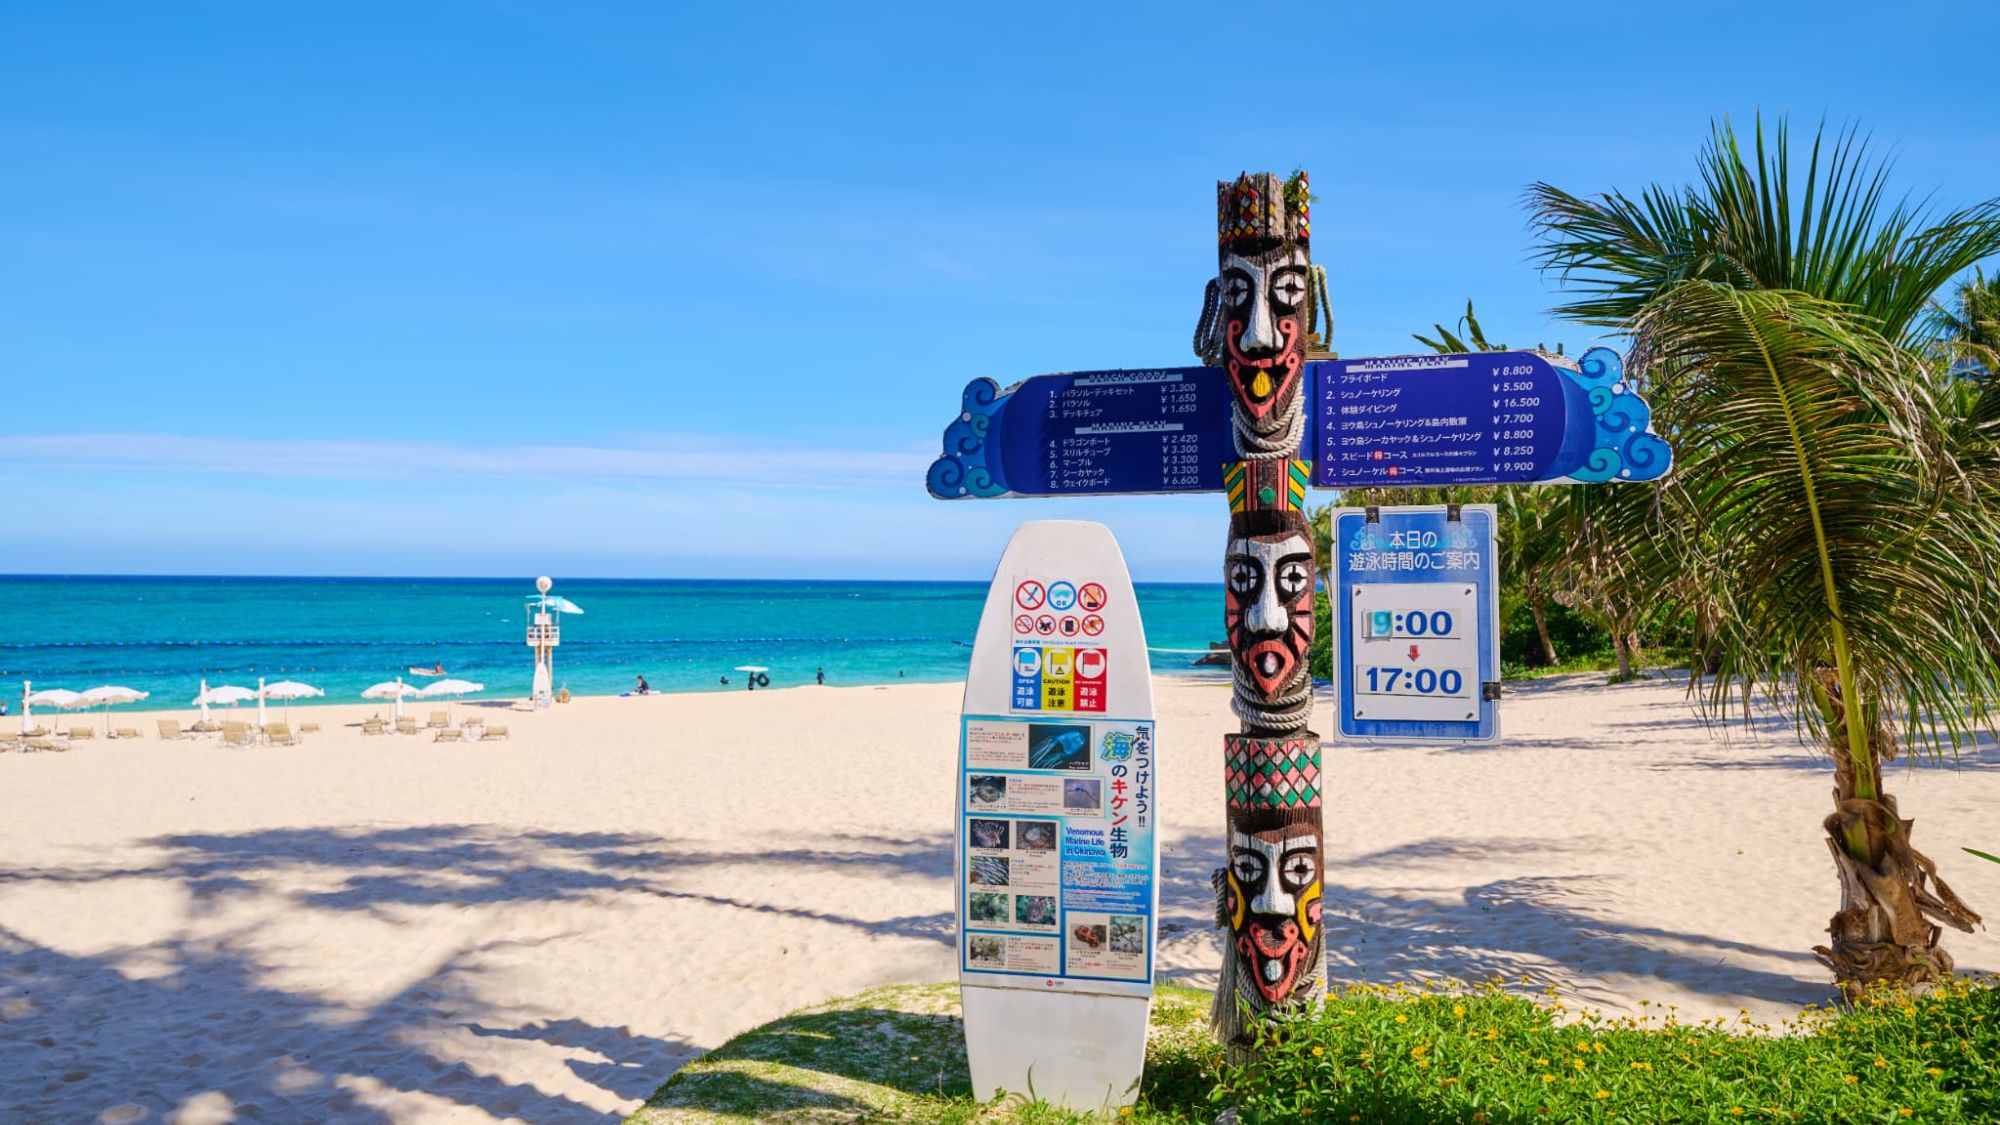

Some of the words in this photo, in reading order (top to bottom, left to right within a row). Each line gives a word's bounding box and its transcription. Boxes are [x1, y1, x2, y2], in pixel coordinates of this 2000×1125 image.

[1421, 357, 1450, 367] PLAY
[1340, 374, 1388, 384] フライボード
[1340, 388, 1401, 398] シュノーケリング
[1341, 404, 1397, 414] 体験ダイビング
[1390, 530, 1438, 549] 本日の
[1349, 552, 1480, 570] 遊泳時間のご案内
[1374, 610, 1452, 636] 9:00
[1366, 667, 1462, 694] 17:00
[1066, 827, 1104, 836] Venomous
[1065, 837, 1090, 845] Marine
[1092, 838, 1104, 846] Life
[1074, 847, 1106, 856] Okinawa
